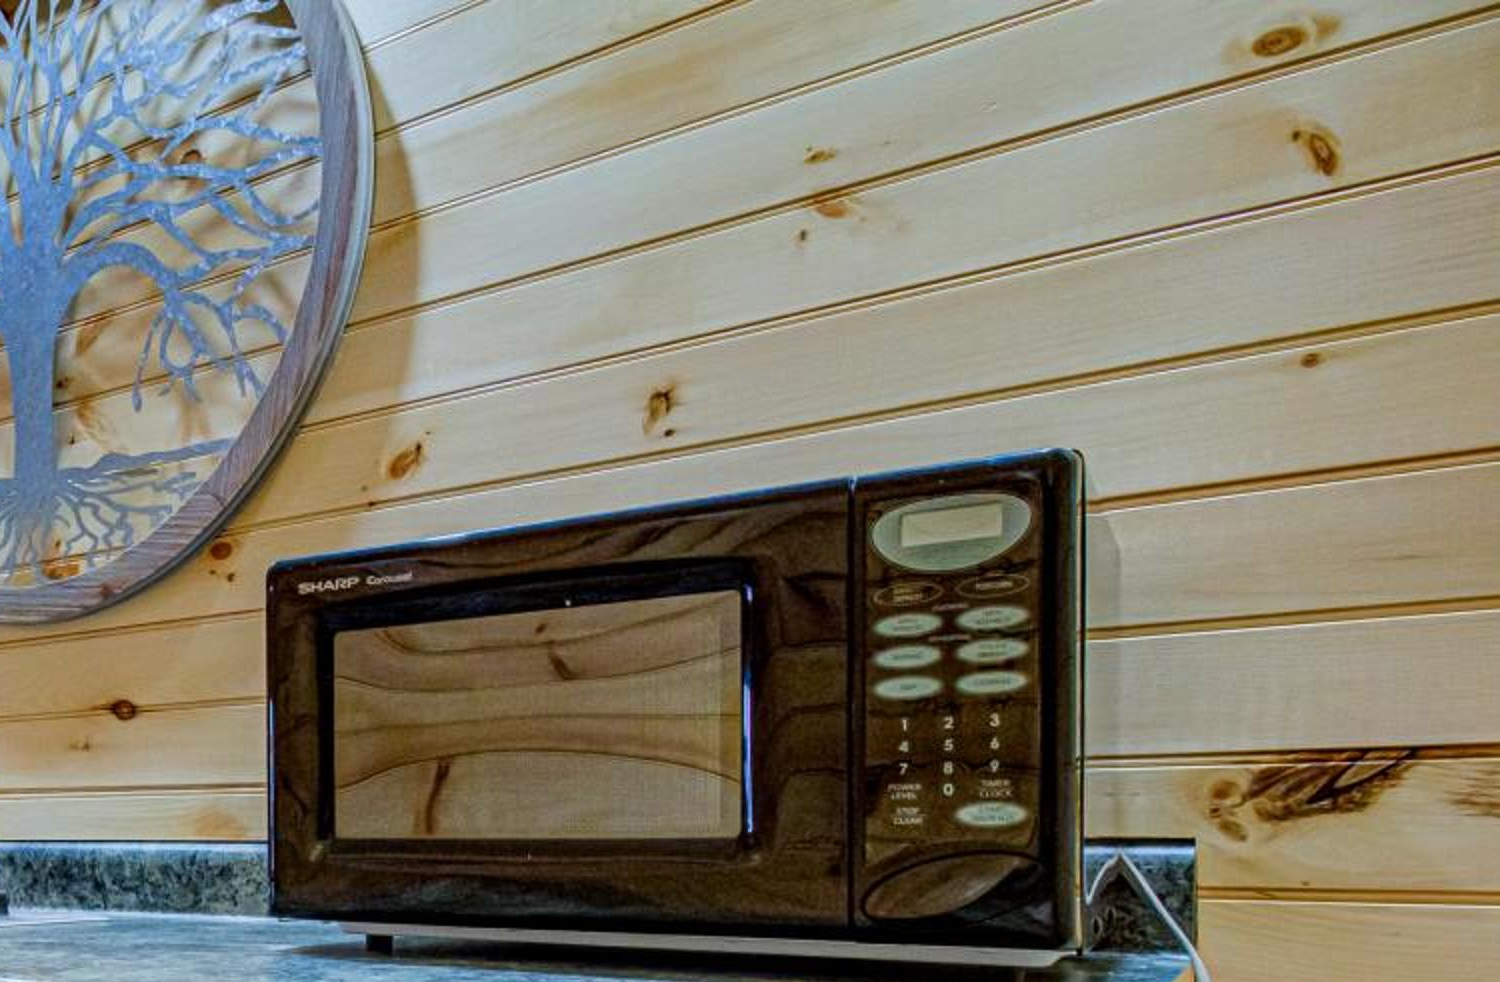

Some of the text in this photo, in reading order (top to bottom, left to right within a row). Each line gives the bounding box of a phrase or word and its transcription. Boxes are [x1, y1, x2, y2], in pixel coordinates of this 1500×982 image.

[297, 576, 360, 595] SHARP
[902, 713, 1000, 731] 1 2 3
[899, 737, 1000, 752] 4 5 6
[900, 759, 1000, 775] 7 8 9
[942, 783, 954, 797] 0
